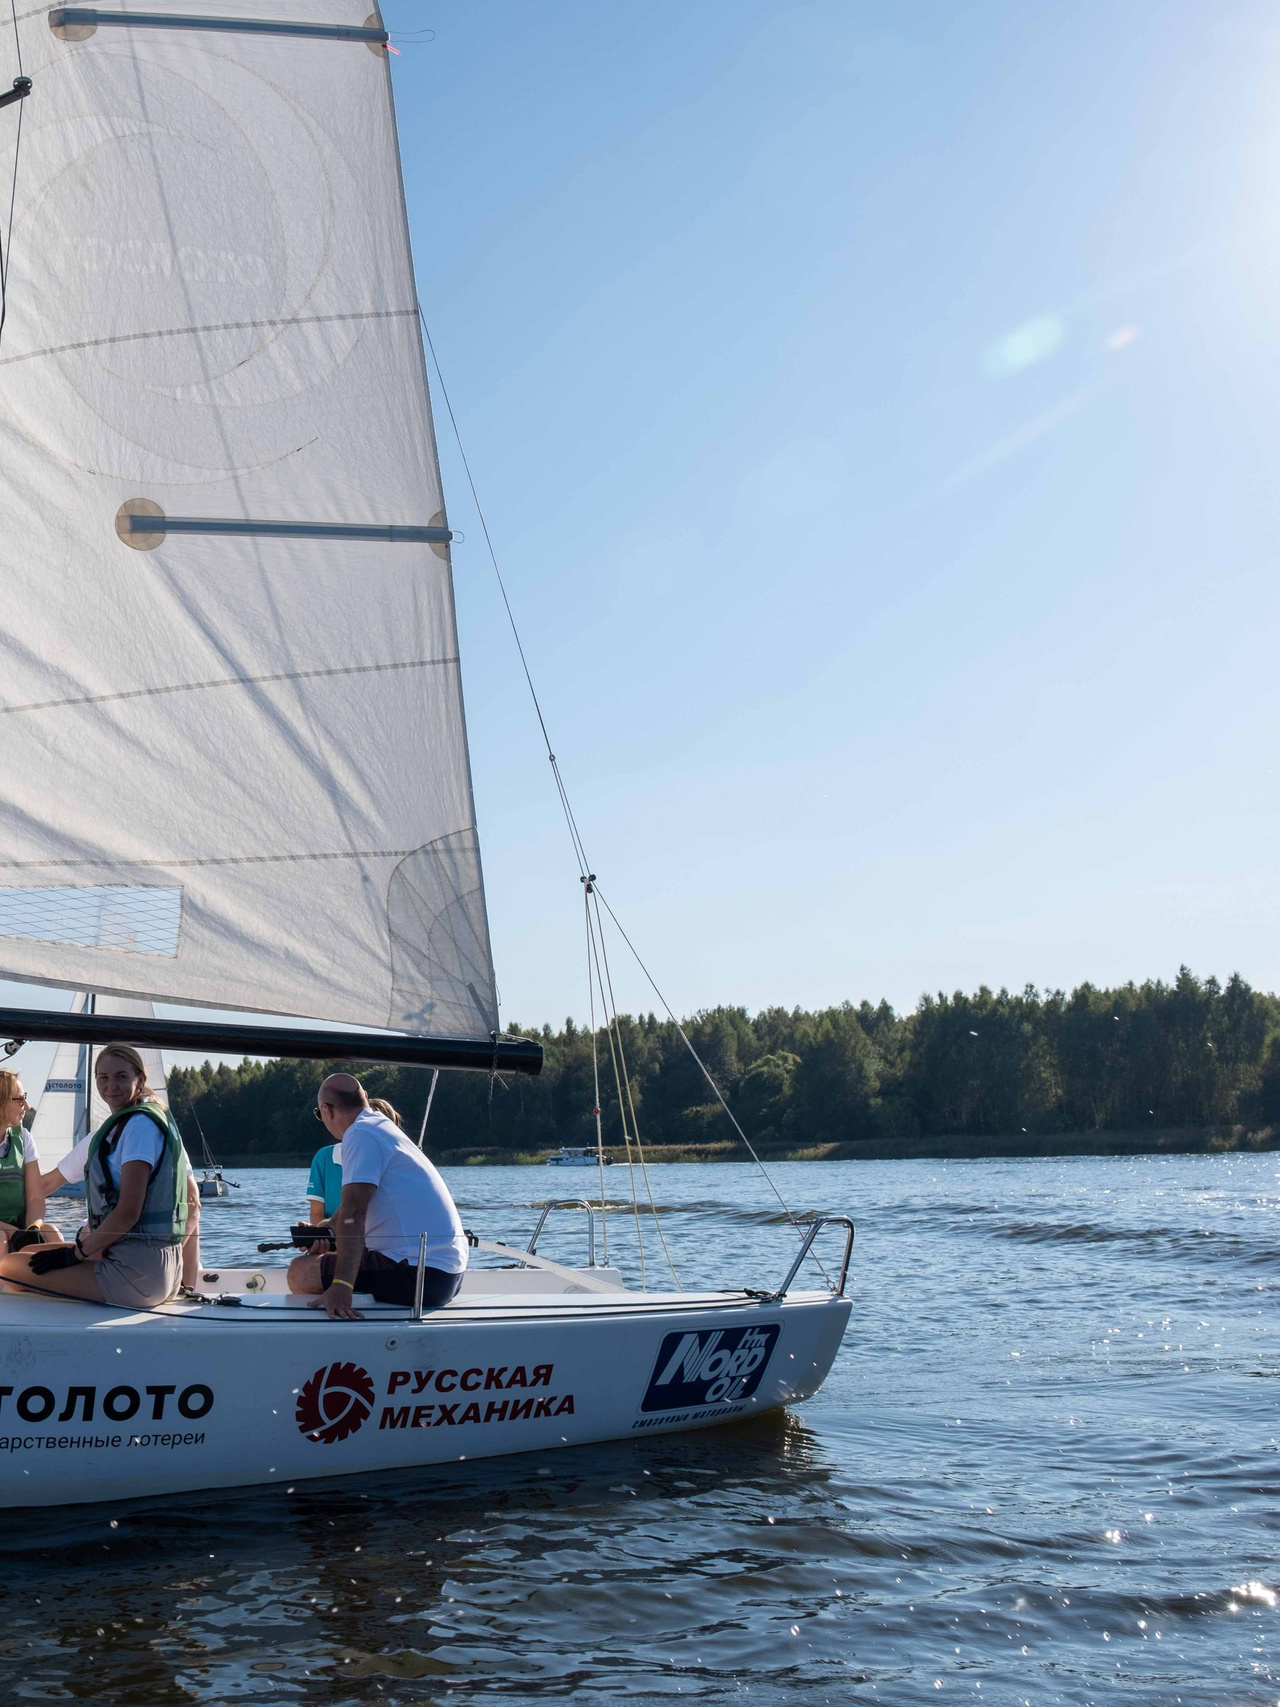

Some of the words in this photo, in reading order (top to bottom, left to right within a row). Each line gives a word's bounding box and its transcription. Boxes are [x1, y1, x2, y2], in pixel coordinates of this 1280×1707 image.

[386, 1363, 554, 1395] РУССКАЯ
[378, 1394, 575, 1430] МЕХАНИКА
[126, 1431, 206, 1450] лотереи
